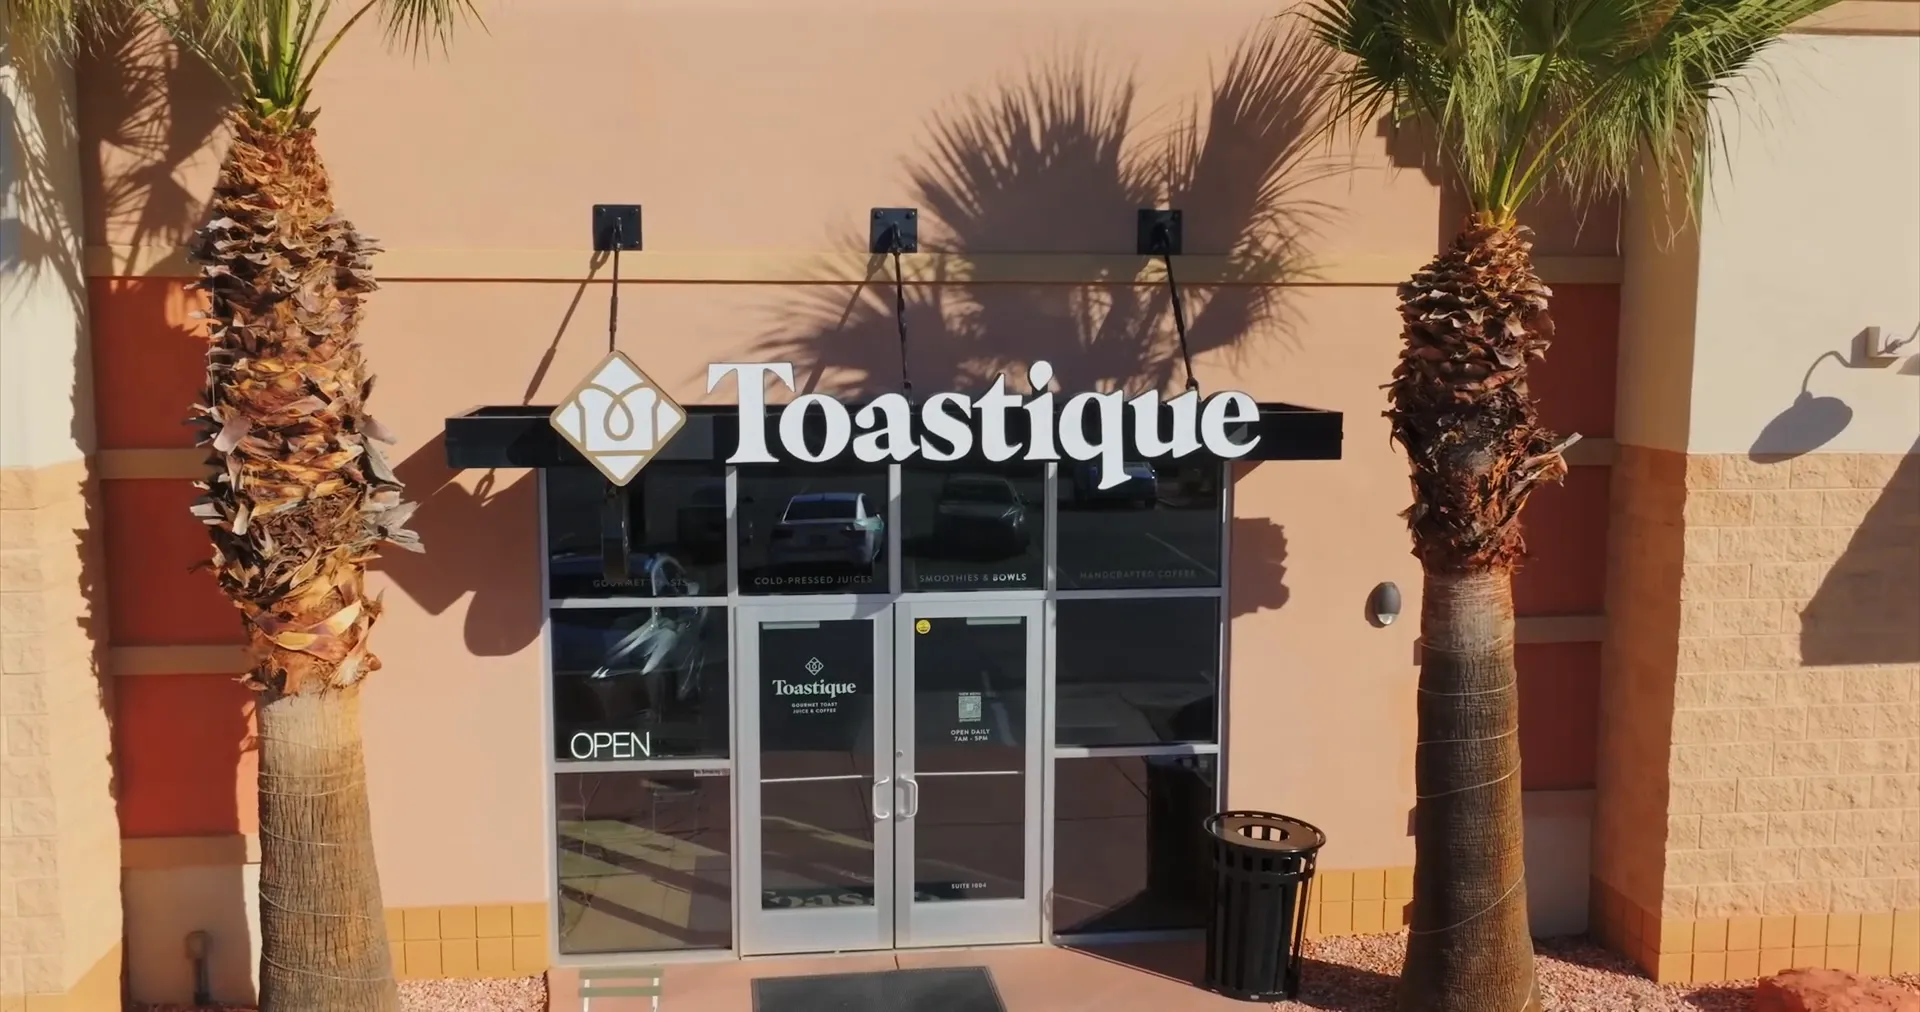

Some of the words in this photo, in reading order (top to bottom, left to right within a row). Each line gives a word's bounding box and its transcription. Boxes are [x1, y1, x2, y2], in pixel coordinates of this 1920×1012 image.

[706, 360, 1261, 490] Toastique
[754, 576, 834, 585] COLD-PRESSED
[836, 575, 873, 584] JUICES
[919, 573, 979, 583] SMOOTHIES
[982, 573, 989, 582] &
[992, 573, 1027, 581] BOWLS
[1079, 570, 1155, 579] HANDCRAFTED
[1157, 569, 1195, 578] COFFEE
[772, 678, 857, 699] Toastique
[570, 731, 650, 759] OPEN
